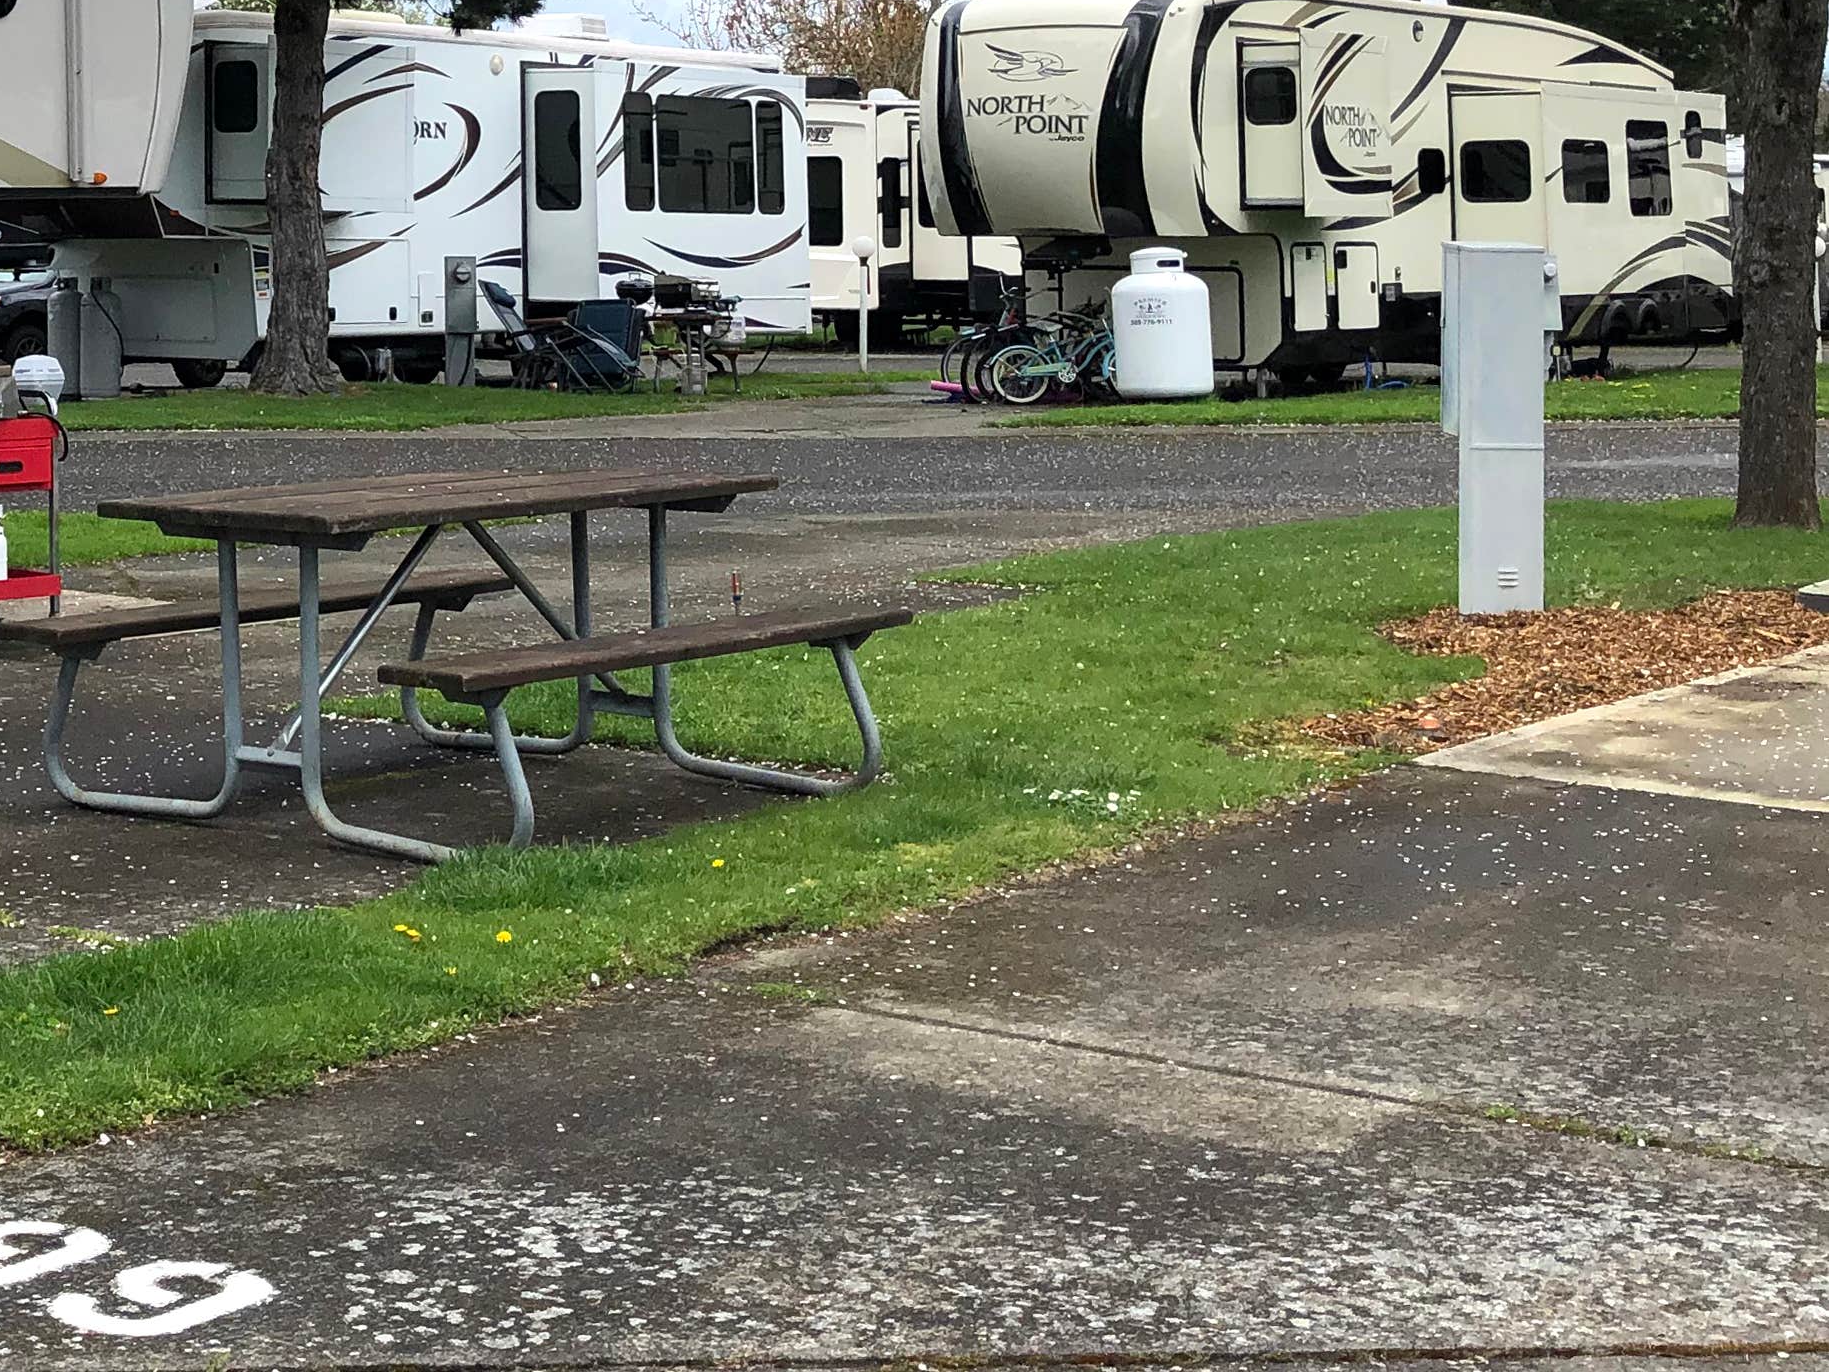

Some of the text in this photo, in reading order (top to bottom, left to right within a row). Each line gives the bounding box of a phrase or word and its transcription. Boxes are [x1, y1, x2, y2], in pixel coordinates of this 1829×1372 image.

[966, 95, 1046, 117] NORTH
[1013, 115, 1089, 134] POINT
[1325, 106, 1360, 126] NORTH
[1348, 128, 1377, 147] POINT
